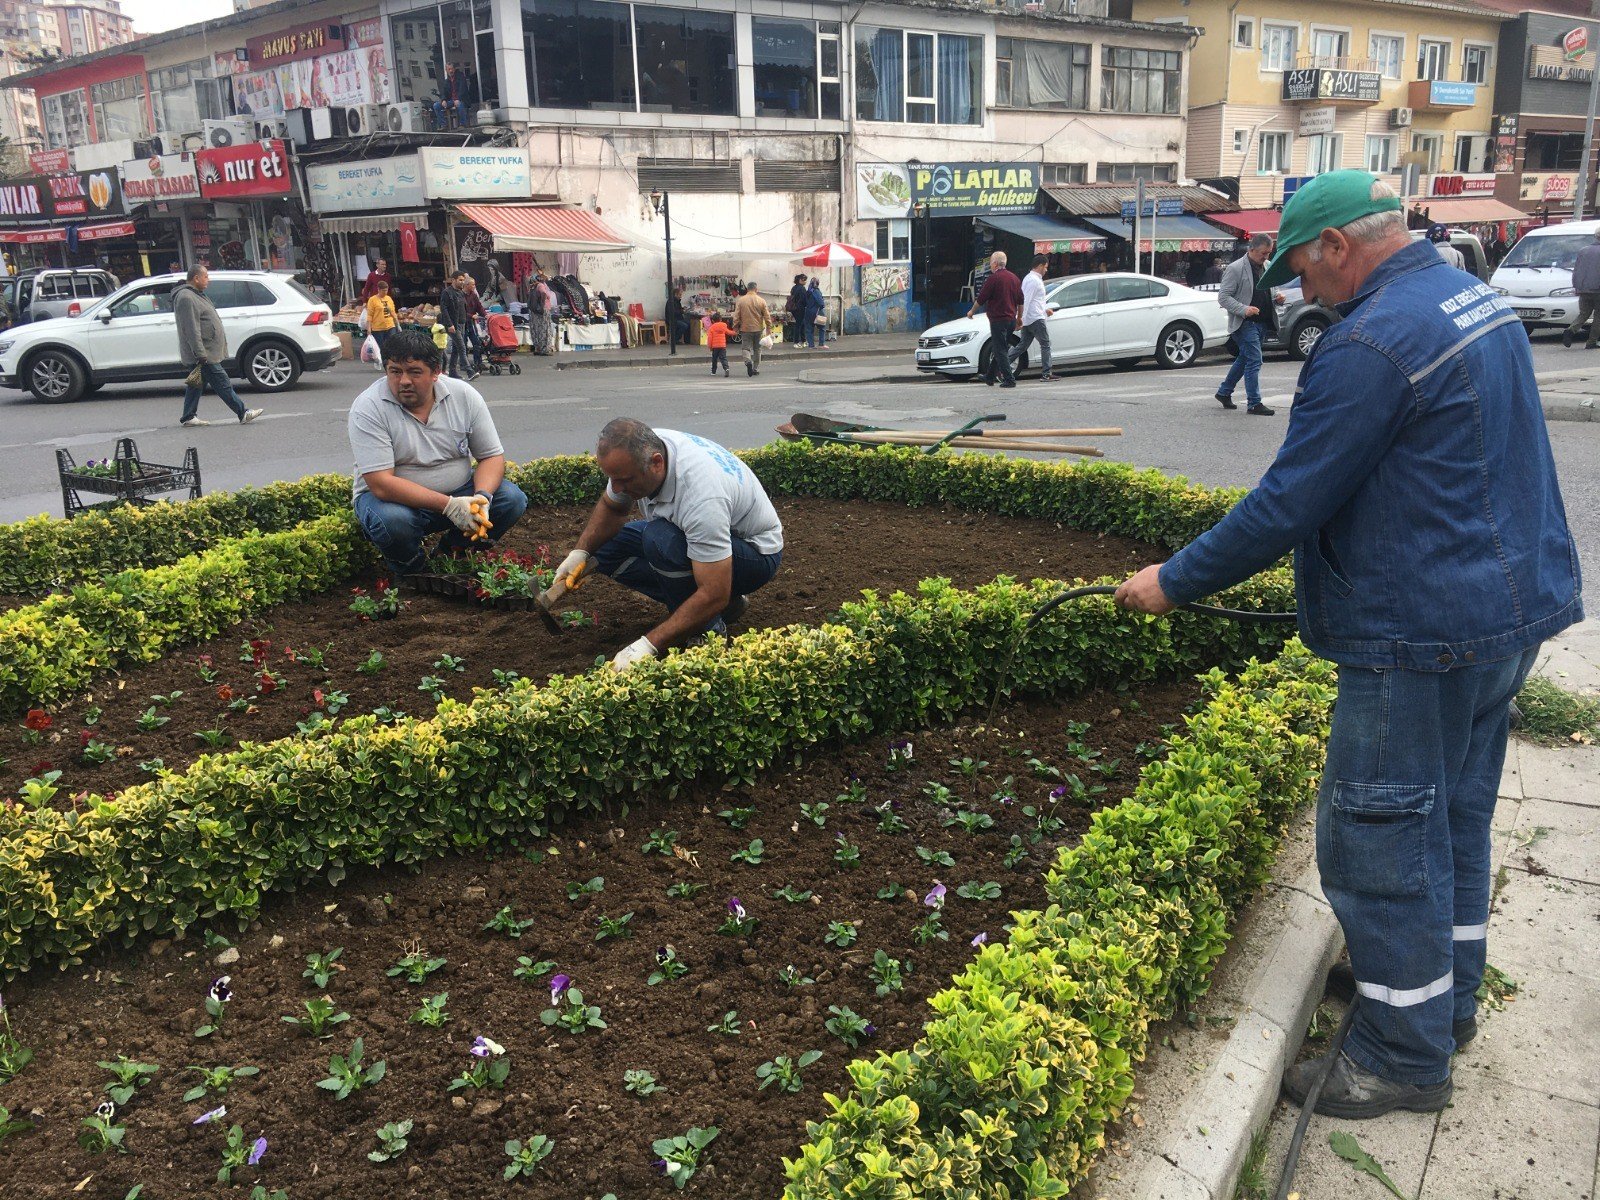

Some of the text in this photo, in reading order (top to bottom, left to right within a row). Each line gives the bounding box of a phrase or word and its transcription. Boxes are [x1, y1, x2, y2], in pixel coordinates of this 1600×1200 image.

[1288, 70, 1316, 84] ASLI
[1536, 64, 1563, 79] KASAP
[1334, 71, 1358, 93] ASLI
[224, 151, 282, 182] nur et
[459, 156, 523, 165] BEREKET YUFKA
[338, 166, 383, 180] BEREKET YUFKA
[1433, 175, 1464, 196] NUR
